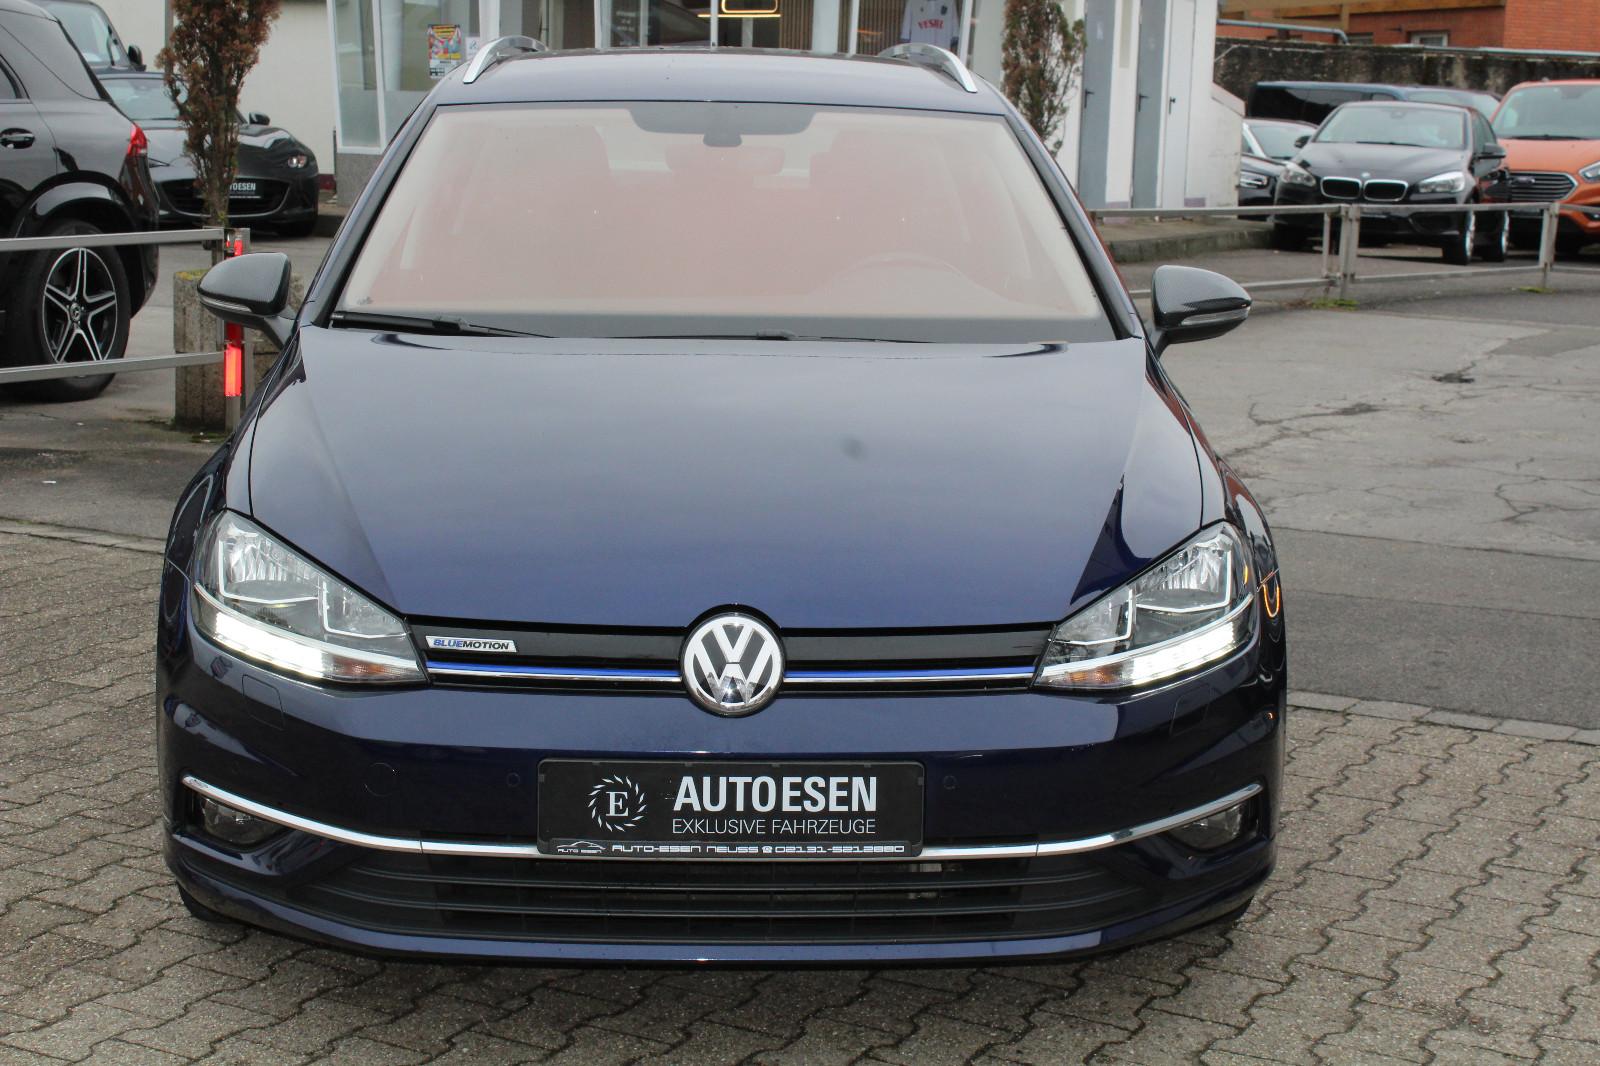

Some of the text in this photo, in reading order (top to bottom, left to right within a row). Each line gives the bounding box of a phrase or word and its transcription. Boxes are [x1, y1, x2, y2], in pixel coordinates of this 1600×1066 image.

[433, 639, 510, 650] BLUEMOTION
[673, 775, 877, 813] AUTOESEN
[605, 791, 629, 817] E
[672, 818, 876, 835] EXKLUSIVE FAHRZEUGE
[612, 844, 701, 853] AUTO-ESEN
[706, 845, 759, 854] NEUSS
